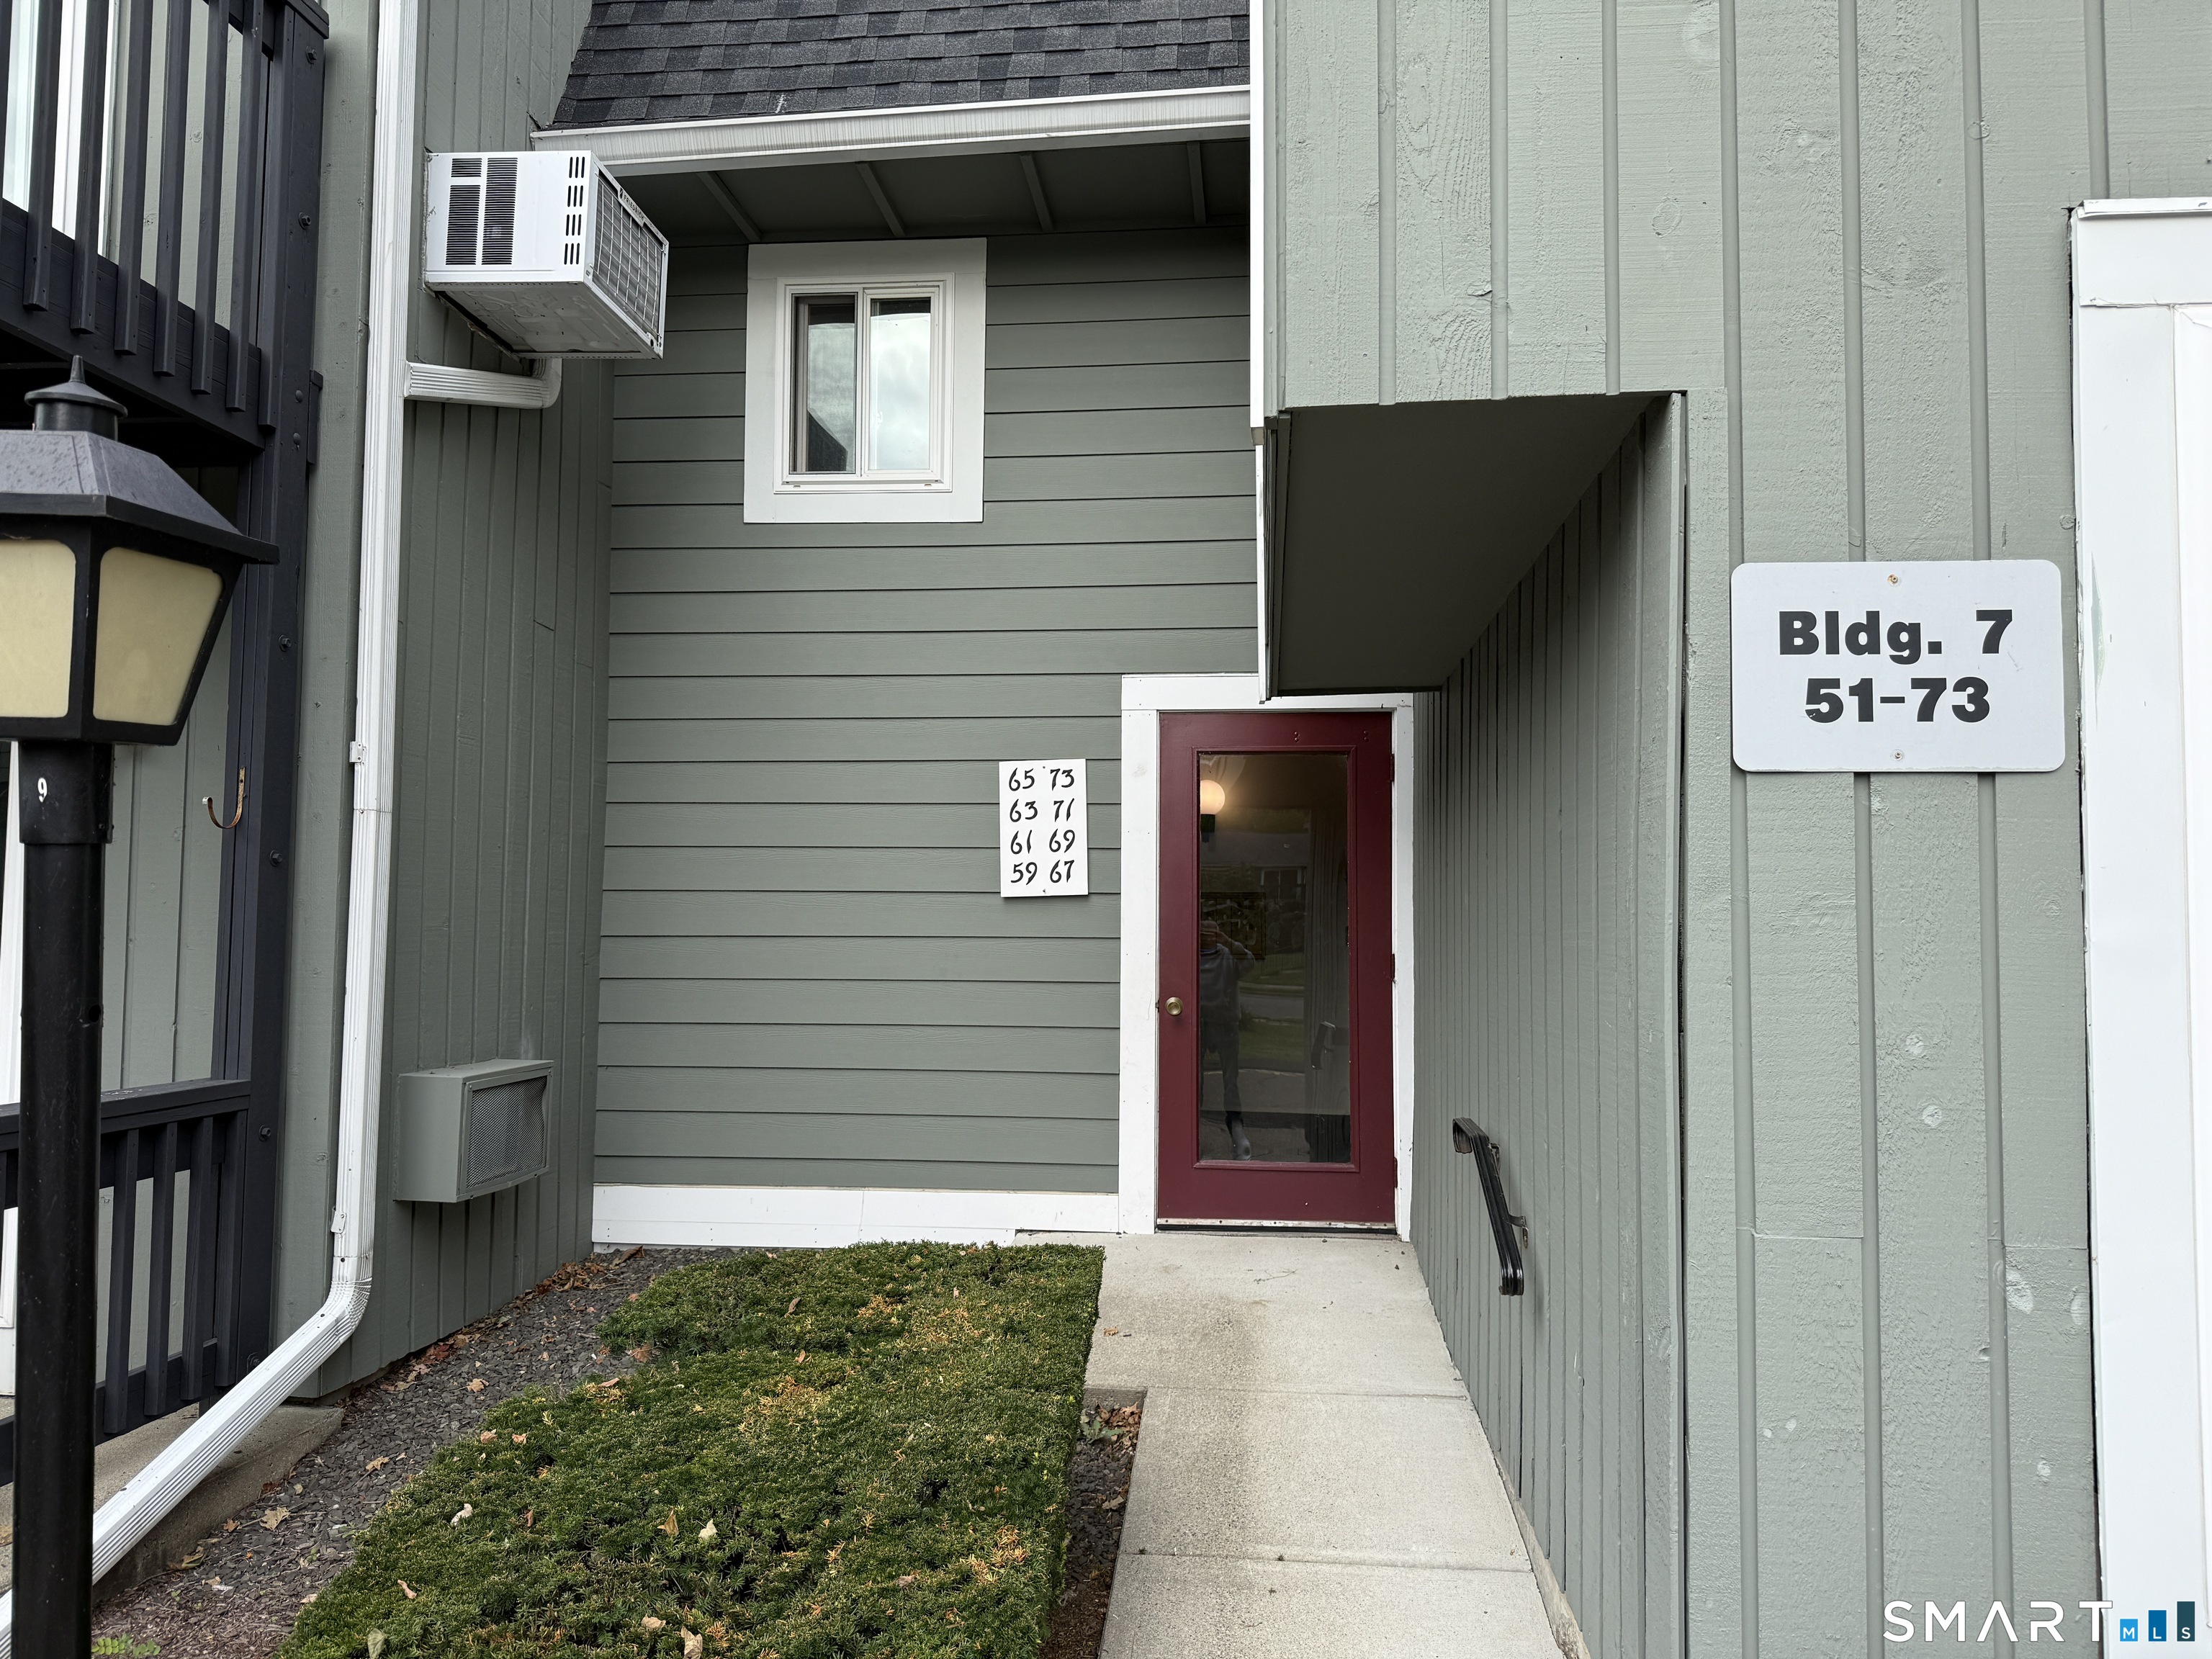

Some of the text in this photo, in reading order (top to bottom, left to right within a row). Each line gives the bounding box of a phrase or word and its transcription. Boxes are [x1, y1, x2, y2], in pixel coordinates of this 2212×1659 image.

[1779, 609, 2013, 665] Bldg. 7
[1804, 676, 1990, 724] 51-73
[37, 778, 48, 802] 9
[1009, 768, 1074, 791] 65 73
[1010, 798, 1074, 822] 63 71
[1010, 829, 1076, 855] 61 69
[1010, 860, 1074, 885] 59 67
